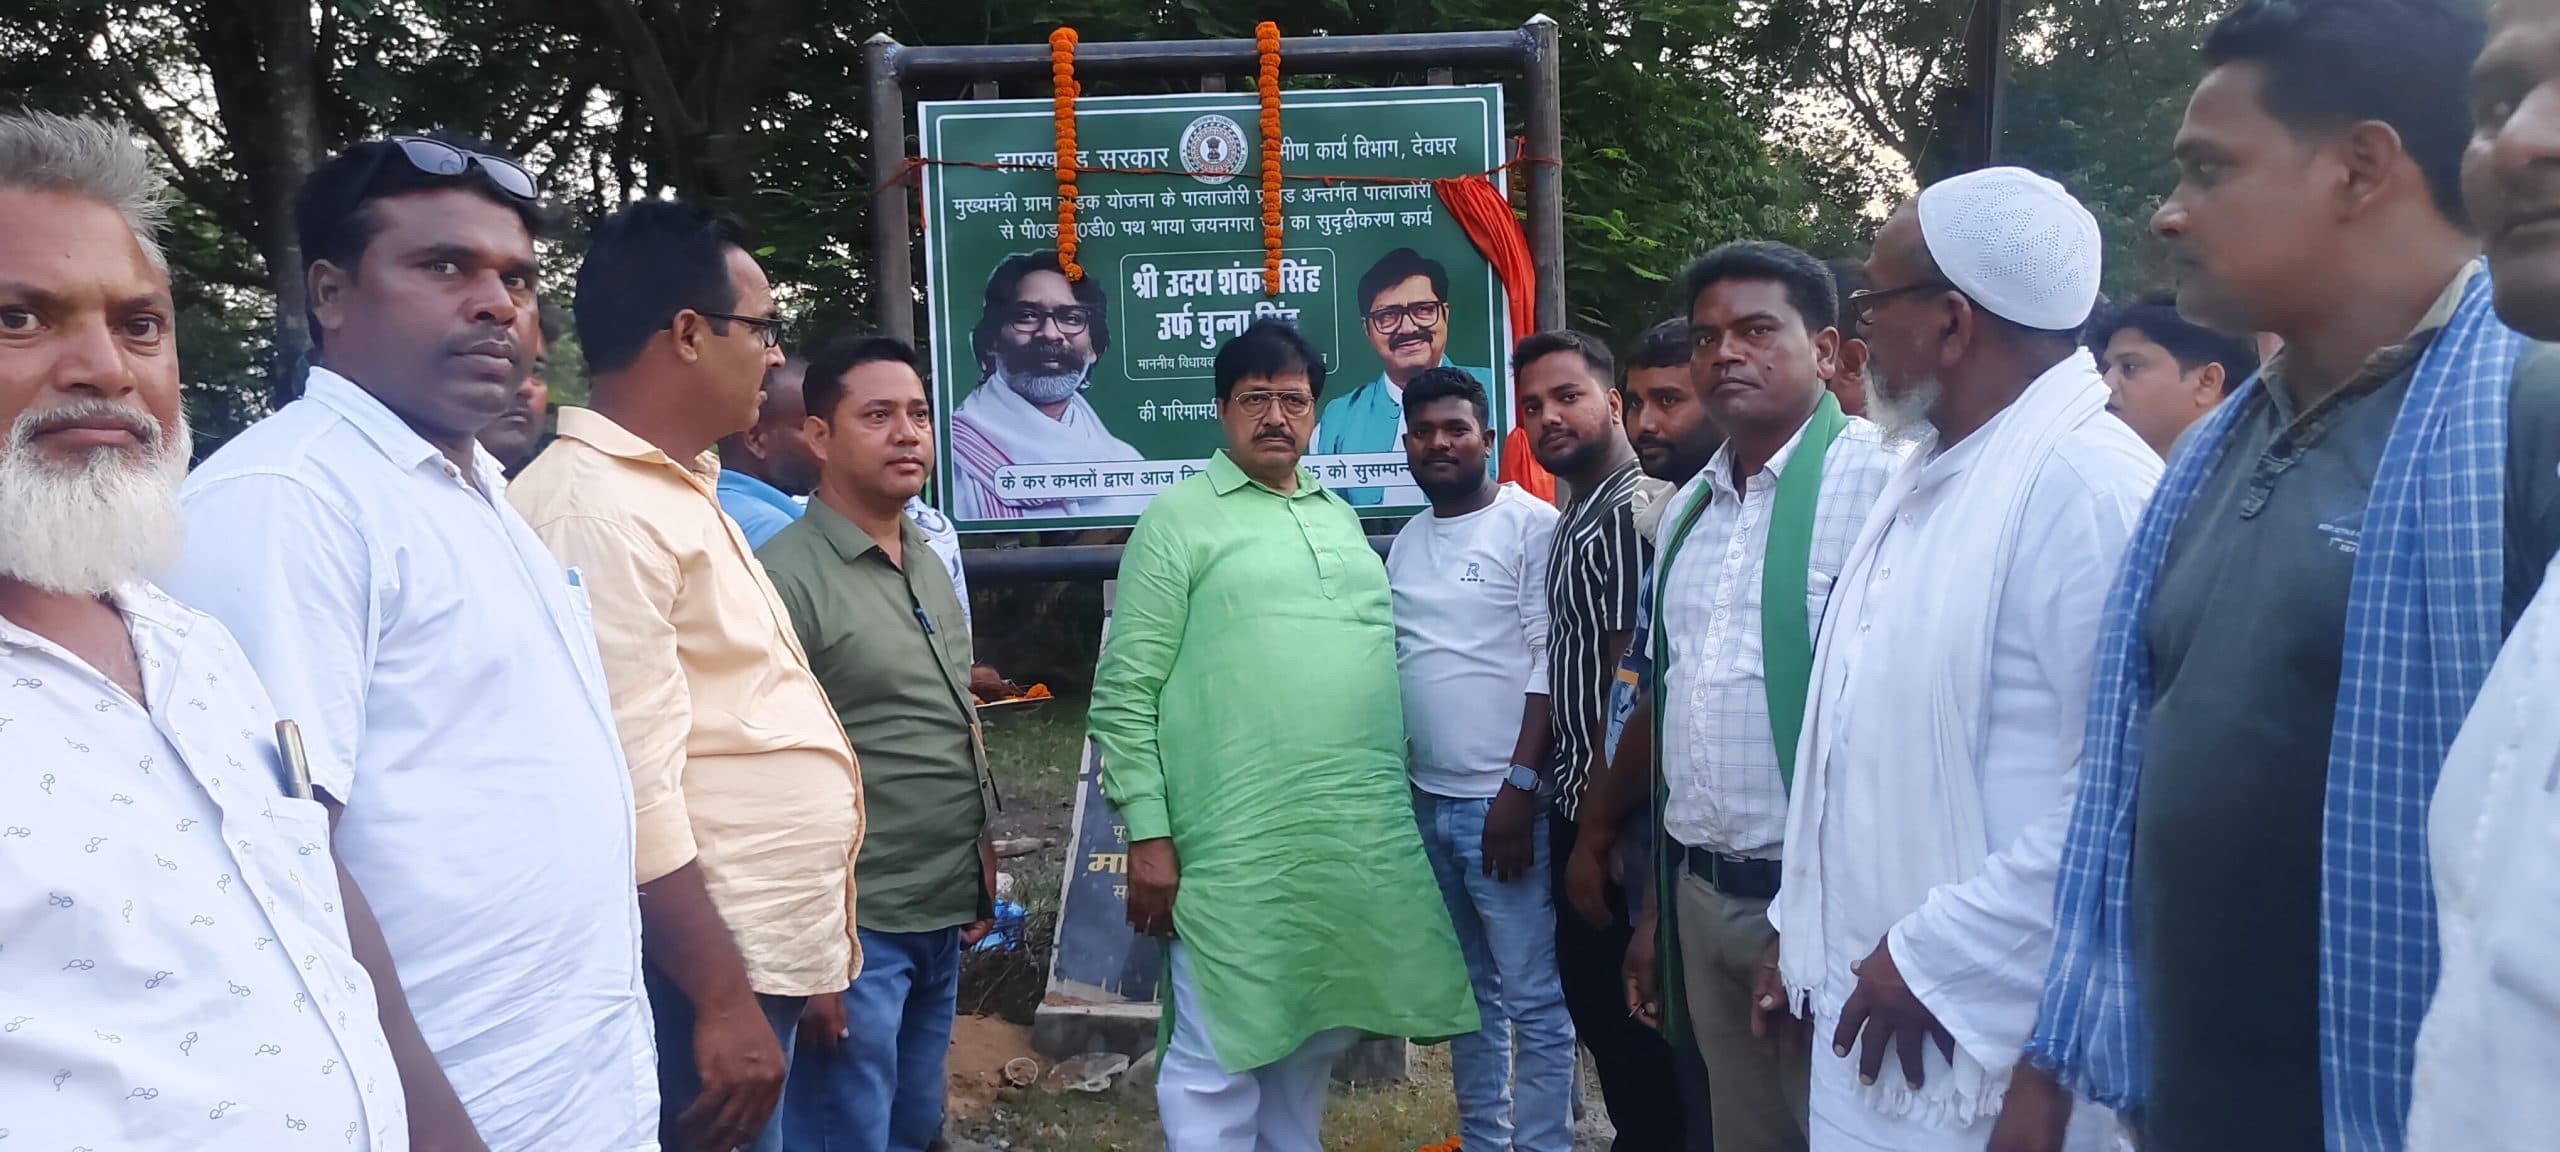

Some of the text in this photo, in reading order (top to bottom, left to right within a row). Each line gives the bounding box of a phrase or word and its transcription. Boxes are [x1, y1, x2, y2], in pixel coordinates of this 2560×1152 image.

[1314, 133, 1348, 160] कार्य
[1410, 131, 1457, 157] देवघर
[995, 150, 1089, 174] झारखड
[1096, 147, 1170, 169] सरकार
[952, 191, 1017, 220] मुख्यमंत्री
[1022, 195, 1053, 212] ग्राम
[1057, 195, 1100, 214] ड़क
[1105, 189, 1154, 210] योजना
[1160, 186, 1176, 206] के
[1181, 183, 1250, 206] पालाजोरी
[1302, 181, 1357, 203] अन्तर्गत
[1362, 179, 1431, 201] पालाजोरी
[999, 218, 1014, 240] से
[1121, 220, 1145, 236] पथ
[1151, 218, 1185, 236] भाया
[1191, 216, 1254, 234] जयनगरा
[1289, 215, 1310, 231] का
[1316, 207, 1395, 236] सुदृढ़ीकरण
[1400, 204, 1433, 227] कार्य
[1131, 258, 1322, 299] श्री उदय शंक सिंह
[1155, 302, 1194, 340] उर्फ
[1197, 310, 1252, 349] चुन्ना
[1137, 354, 1175, 370] माननीय
[1137, 399, 1156, 422] की
[999, 470, 1016, 491] के
[1021, 474, 1046, 489] कर
[1052, 468, 1098, 489] कमलों
[1103, 471, 1135, 488] द्वारा
[1140, 469, 1175, 486] आज
[1326, 459, 1347, 479] को
